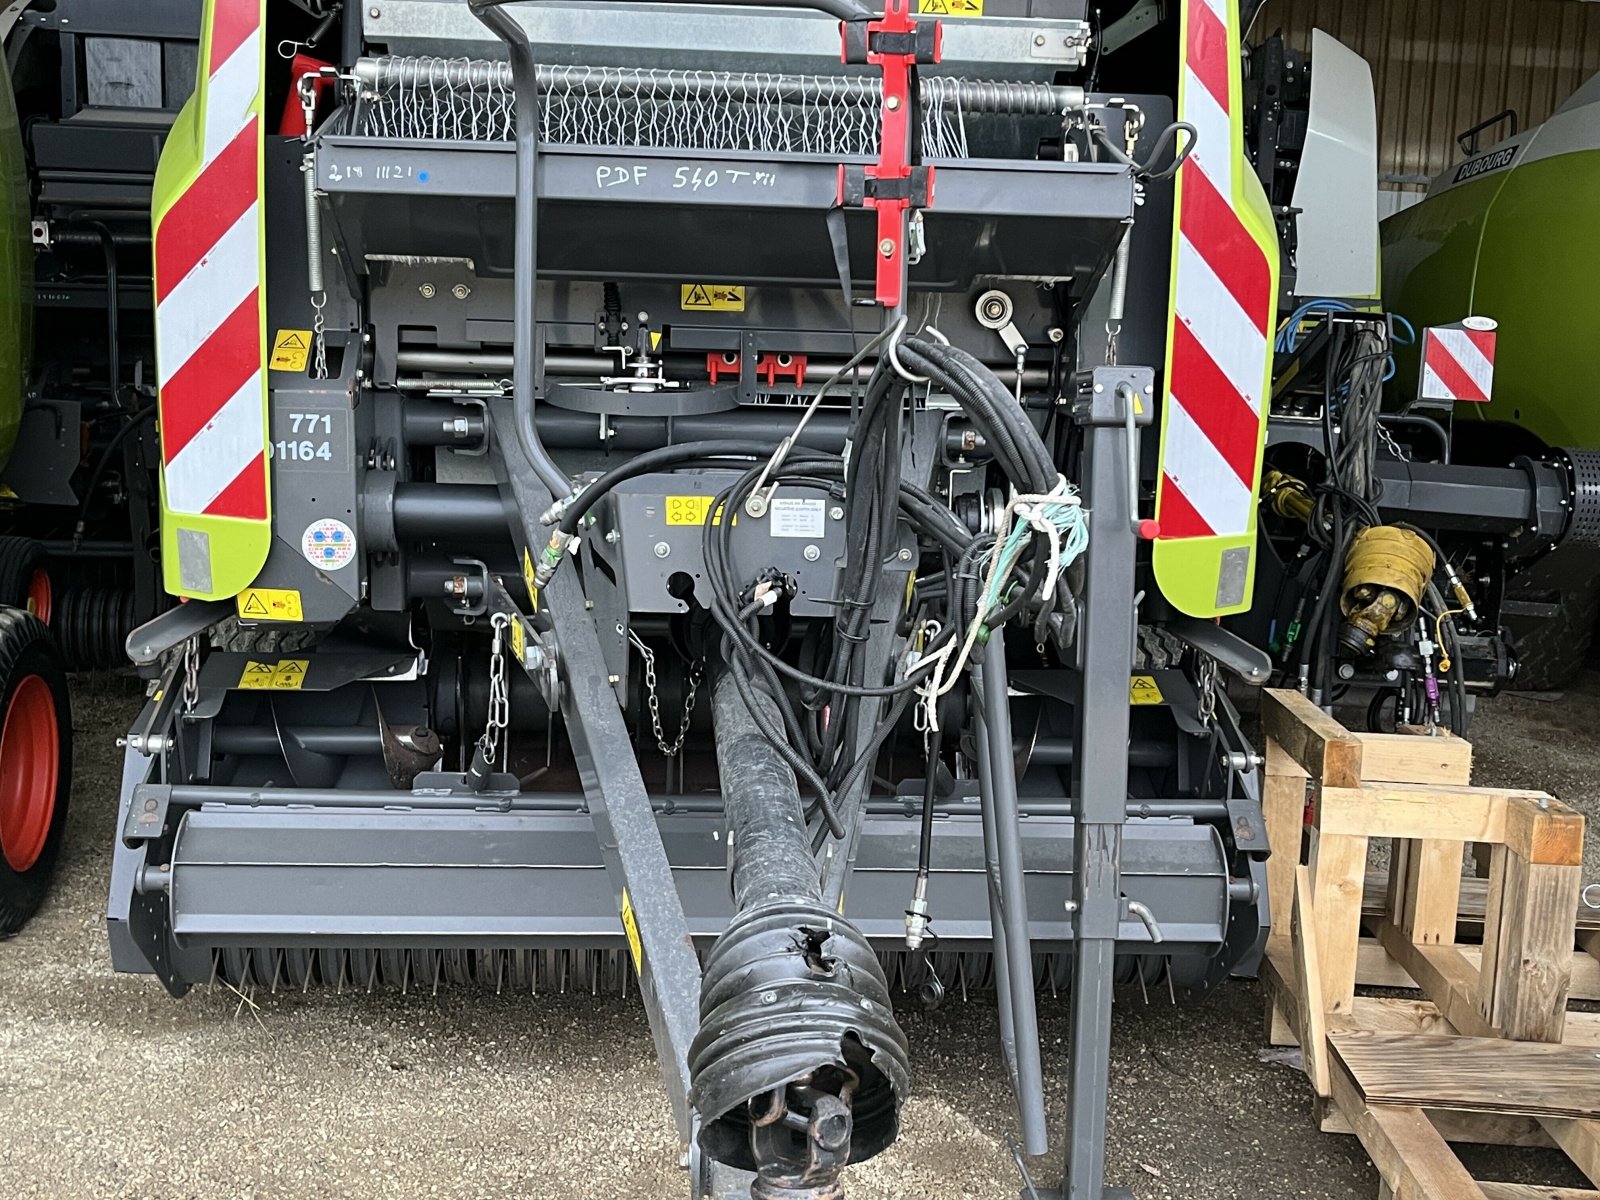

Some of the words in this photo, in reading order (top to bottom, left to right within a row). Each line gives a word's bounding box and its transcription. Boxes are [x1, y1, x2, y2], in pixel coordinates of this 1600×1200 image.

[1458, 148, 1513, 181] DUBOURG
[596, 165, 648, 188] PDF
[289, 413, 331, 434] 771
